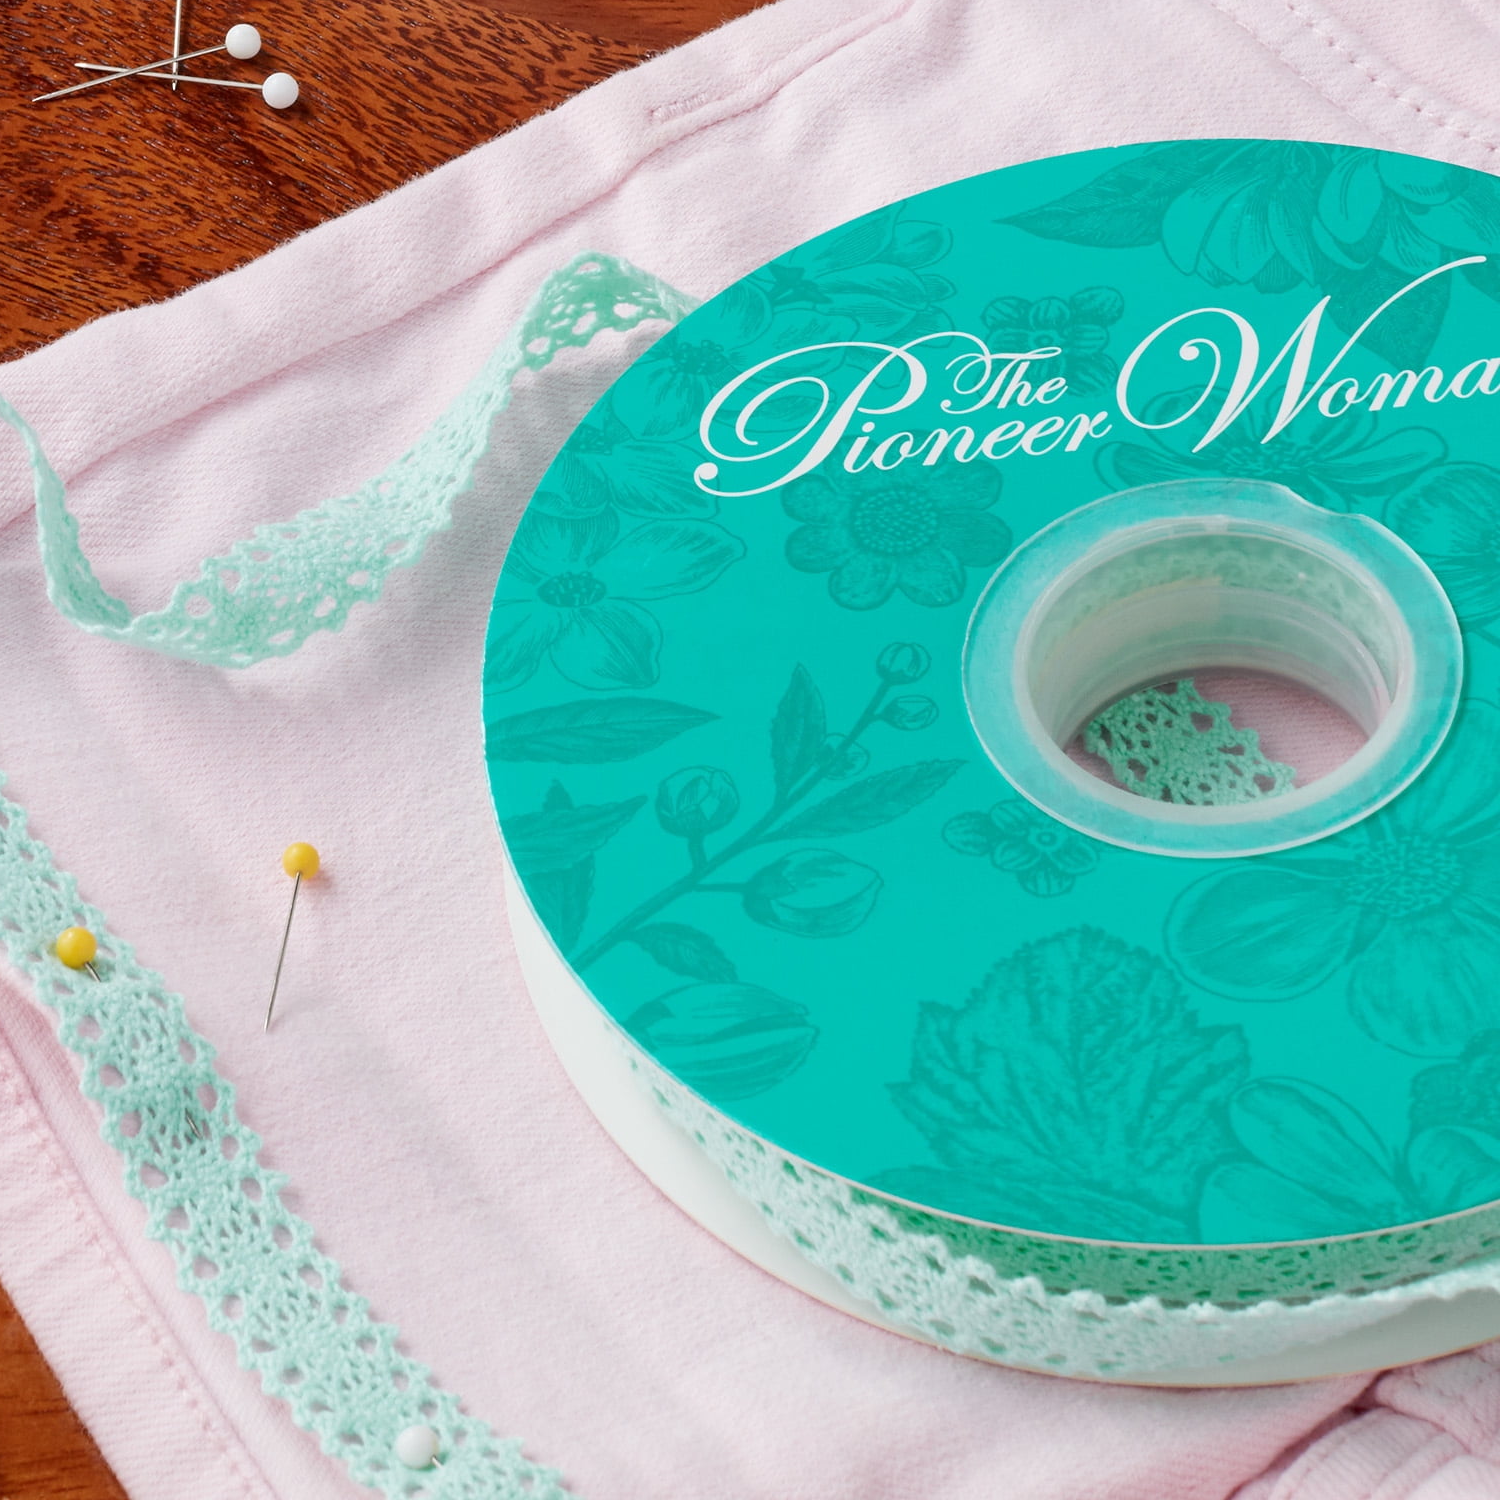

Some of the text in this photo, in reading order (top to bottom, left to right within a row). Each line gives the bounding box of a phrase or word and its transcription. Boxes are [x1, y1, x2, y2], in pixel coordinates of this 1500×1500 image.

[694, 255, 1500, 498] The Pioneer Woma
